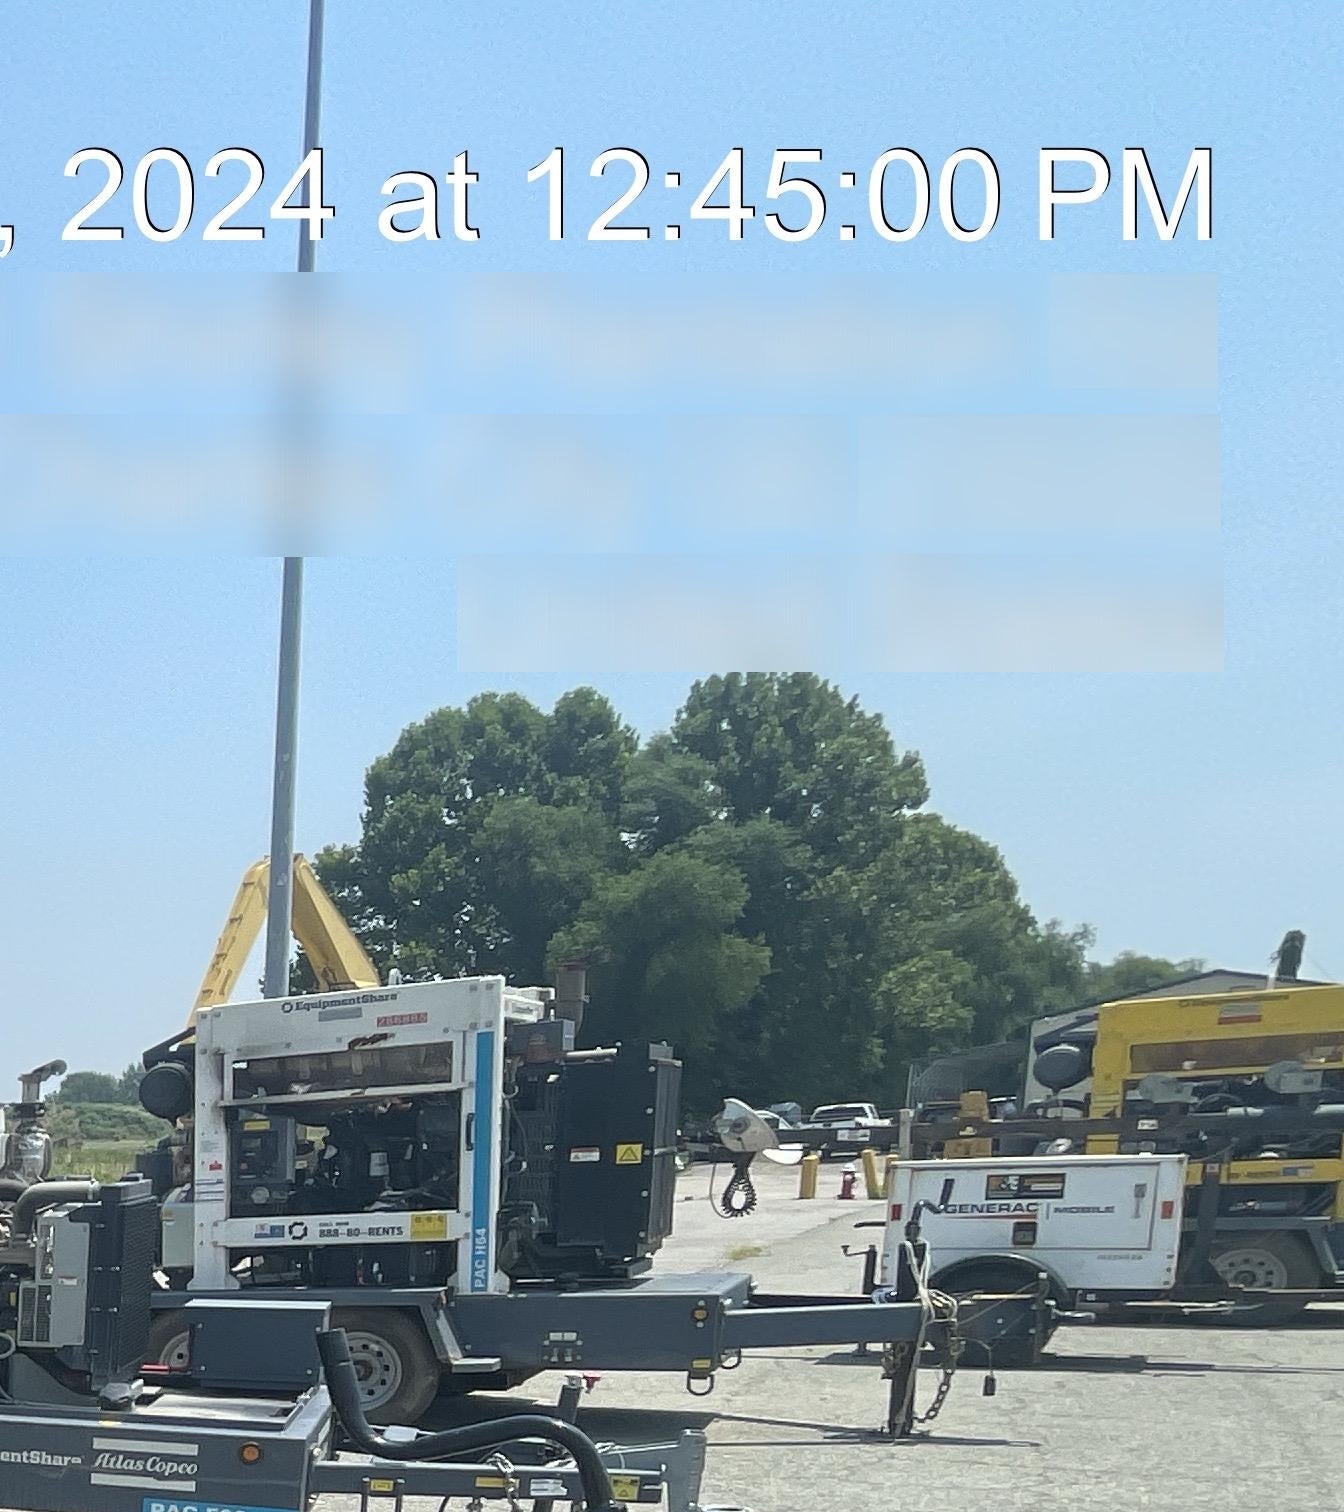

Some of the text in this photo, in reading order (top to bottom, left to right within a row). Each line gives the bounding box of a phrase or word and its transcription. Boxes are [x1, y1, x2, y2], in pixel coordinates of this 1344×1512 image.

[944, 1202, 1115, 1214] GENERAC MOBILE
[94, 1452, 198, 1476] Atlas Copco
